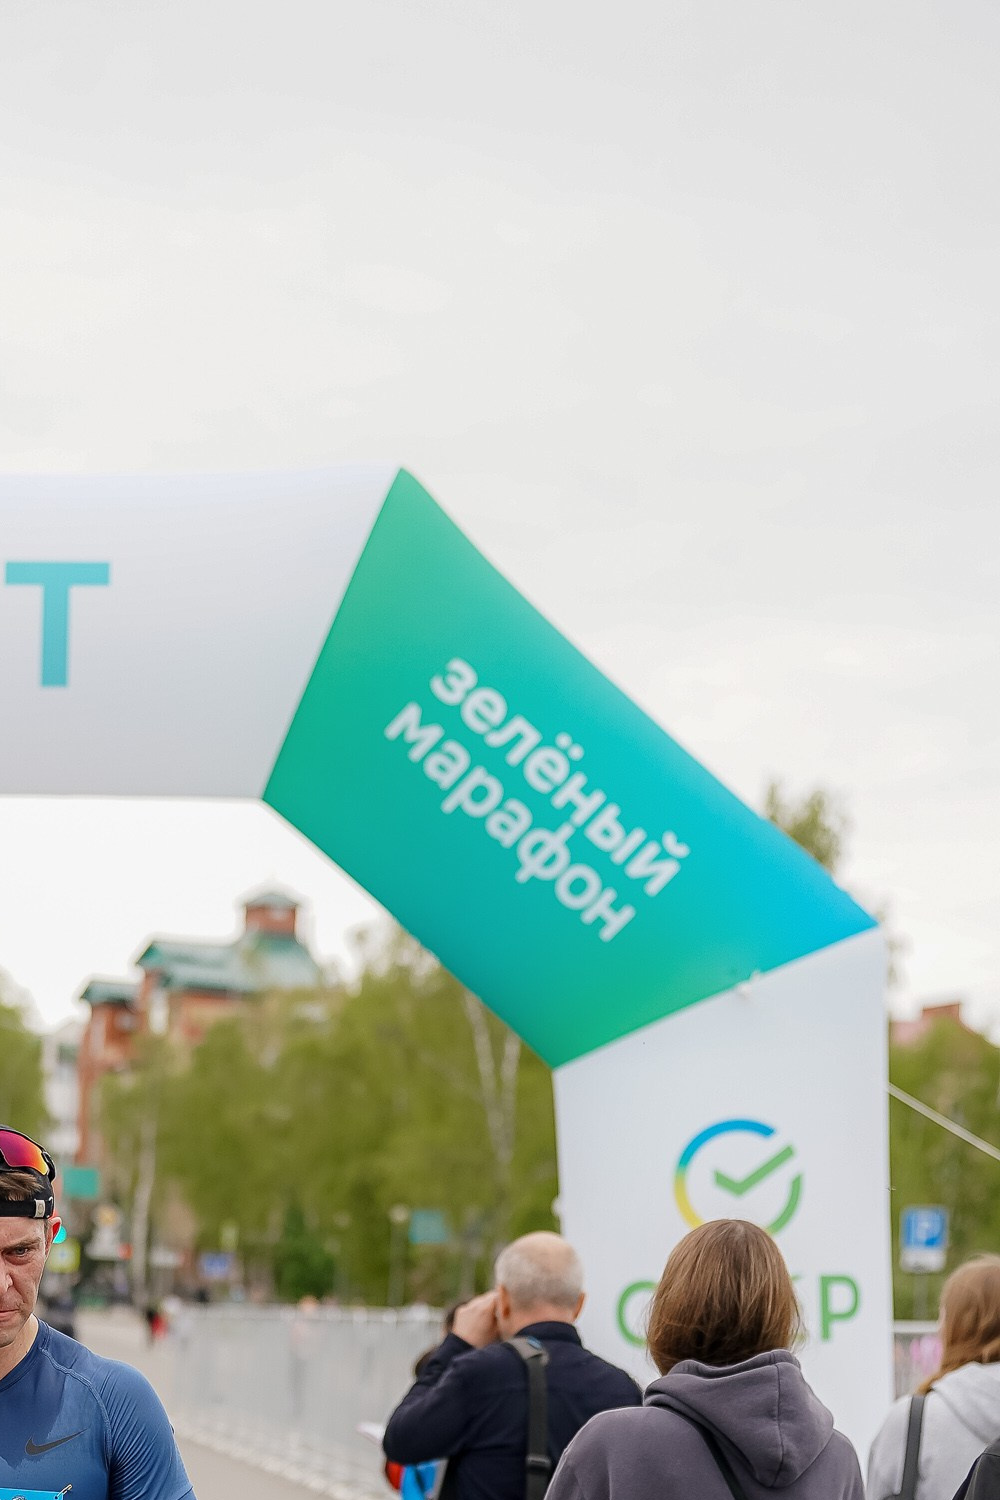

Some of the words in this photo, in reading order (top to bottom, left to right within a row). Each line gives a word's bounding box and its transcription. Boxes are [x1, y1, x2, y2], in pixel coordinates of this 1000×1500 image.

[384, 701, 636, 942] марафон
[429, 657, 691, 898] зелёный
[616, 1274, 861, 1349] СР
